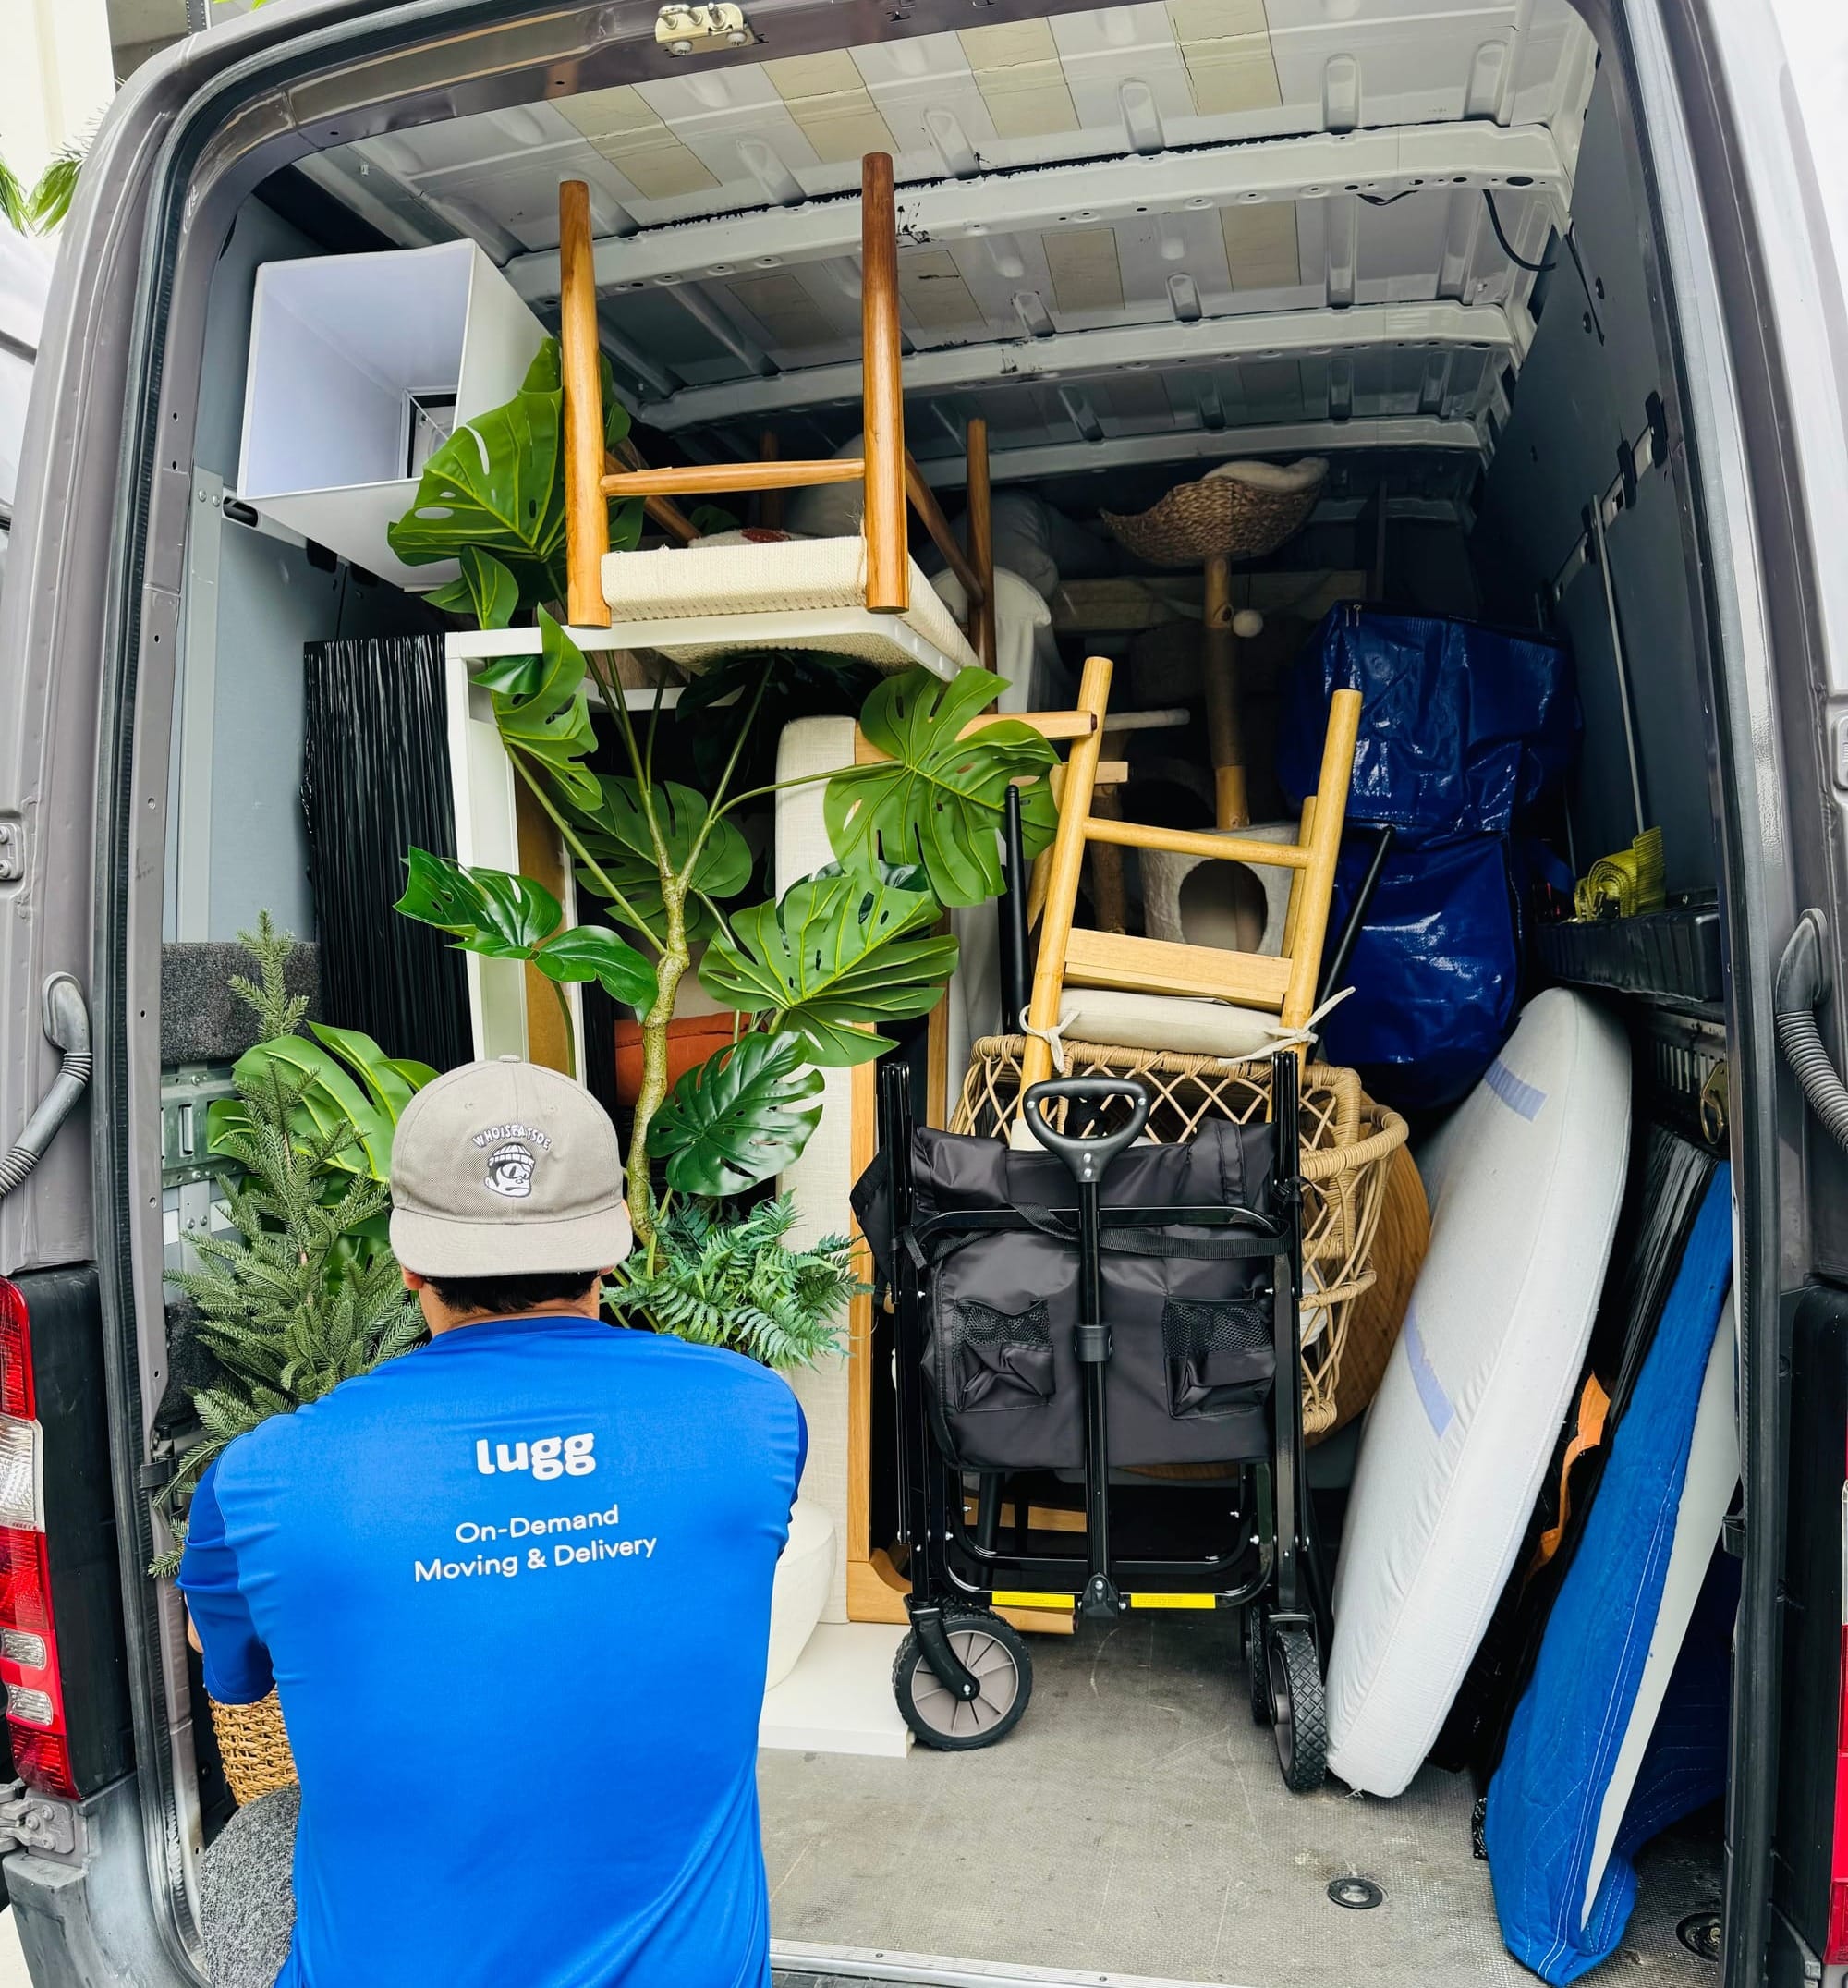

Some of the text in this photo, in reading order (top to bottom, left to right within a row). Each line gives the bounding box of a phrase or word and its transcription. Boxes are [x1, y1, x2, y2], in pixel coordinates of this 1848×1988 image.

[476, 1433, 597, 1481] lugg
[455, 1504, 619, 1543] On-Demand
[414, 1537, 657, 1583] Moving & Delivery
